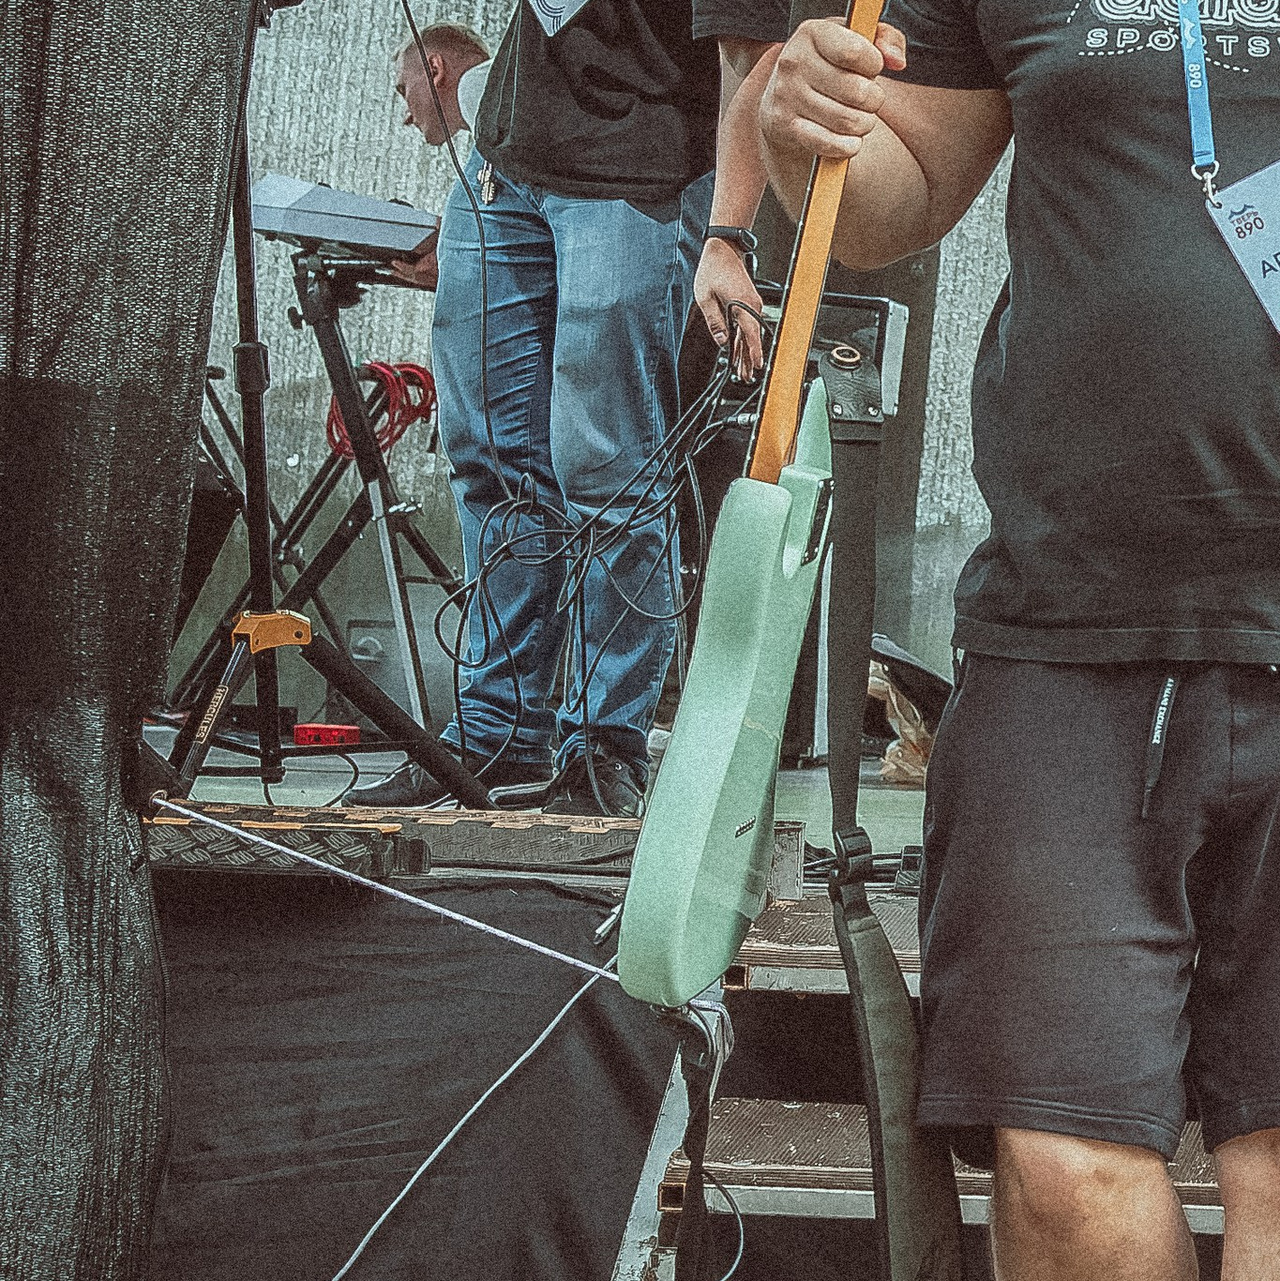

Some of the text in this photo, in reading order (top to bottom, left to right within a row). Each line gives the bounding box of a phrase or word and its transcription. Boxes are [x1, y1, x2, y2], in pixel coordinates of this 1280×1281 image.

[1188, 63, 1202, 88] 890
[1235, 217, 1265, 239] 890
[196, 687, 226, 738] HERCULES
